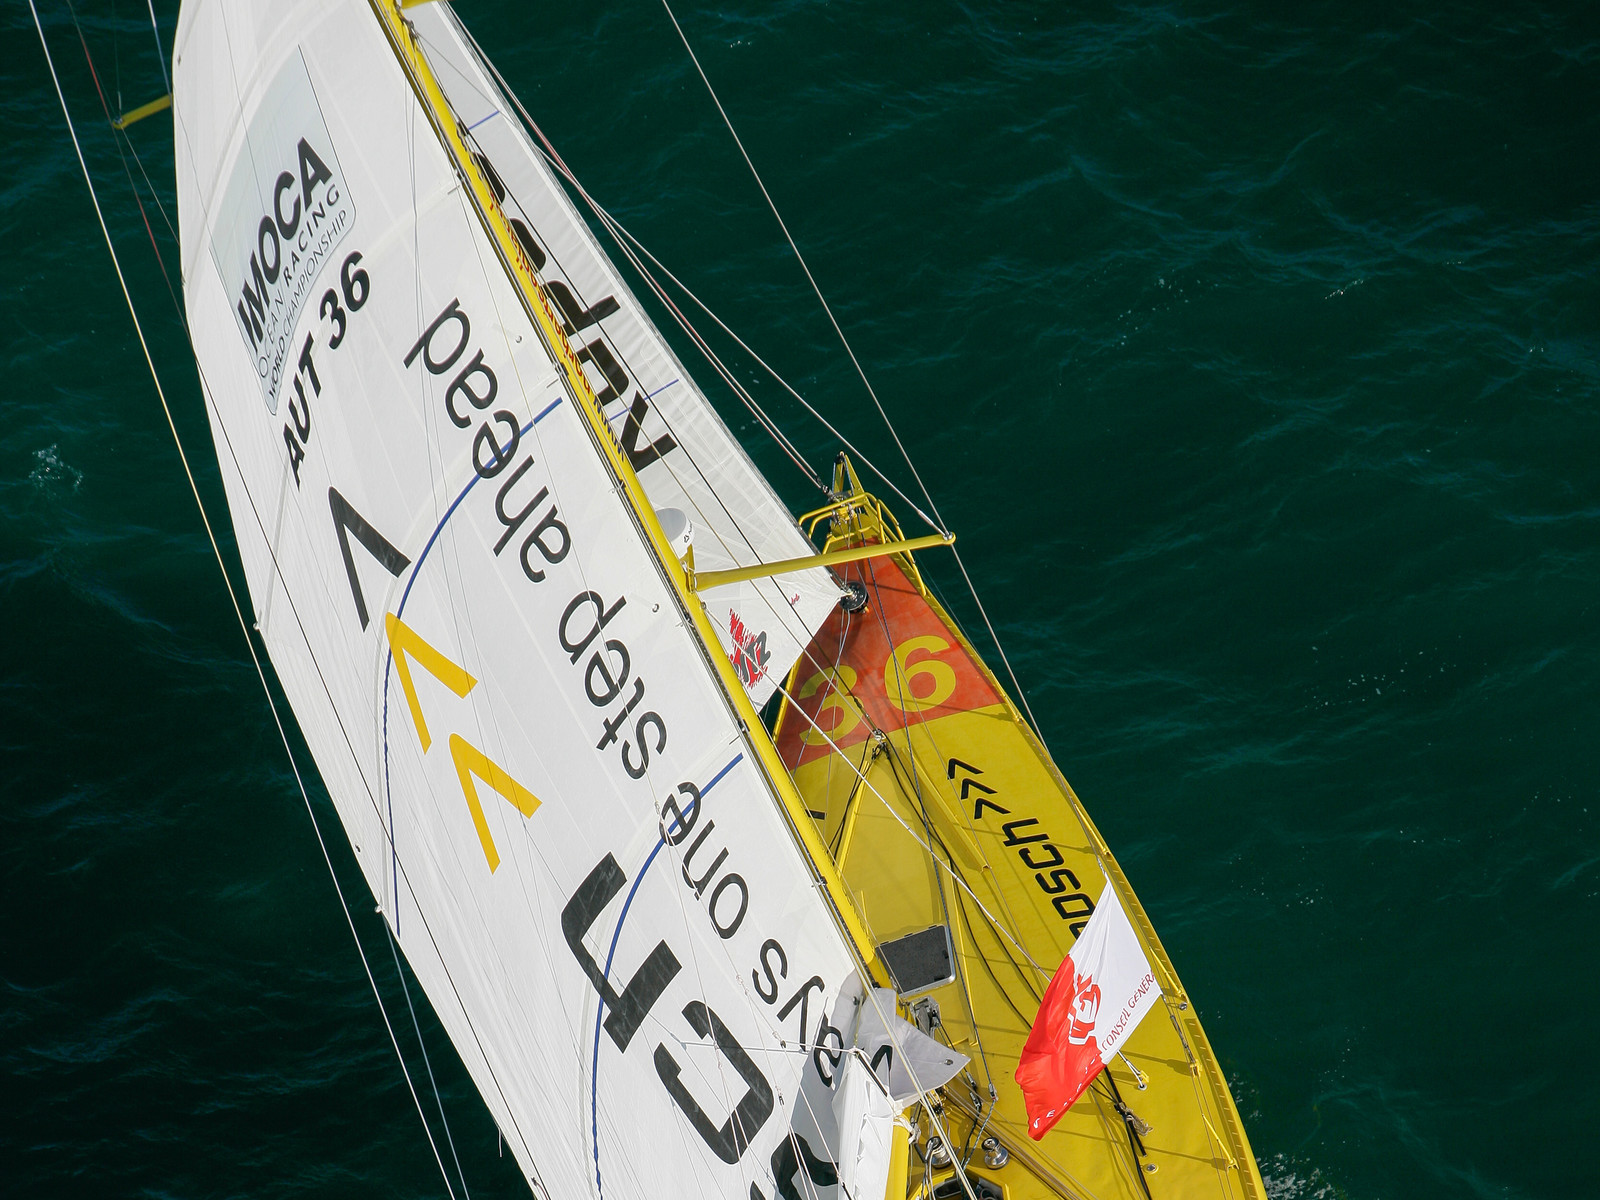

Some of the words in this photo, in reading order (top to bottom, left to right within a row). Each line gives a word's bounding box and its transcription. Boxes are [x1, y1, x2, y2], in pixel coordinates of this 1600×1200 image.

[237, 136, 333, 356] IMOCA
[259, 287, 285, 379] OCEAN
[283, 184, 340, 288] RACING
[283, 209, 347, 338] CHAMPIONSHIP
[283, 331, 322, 492] AUT
[319, 250, 371, 350] 36
[404, 298, 572, 583] ahead
[558, 589, 668, 780] step
[799, 635, 957, 747] 36
[659, 781, 749, 941] one
[1101, 1008, 1131, 1051] CONSEIL
